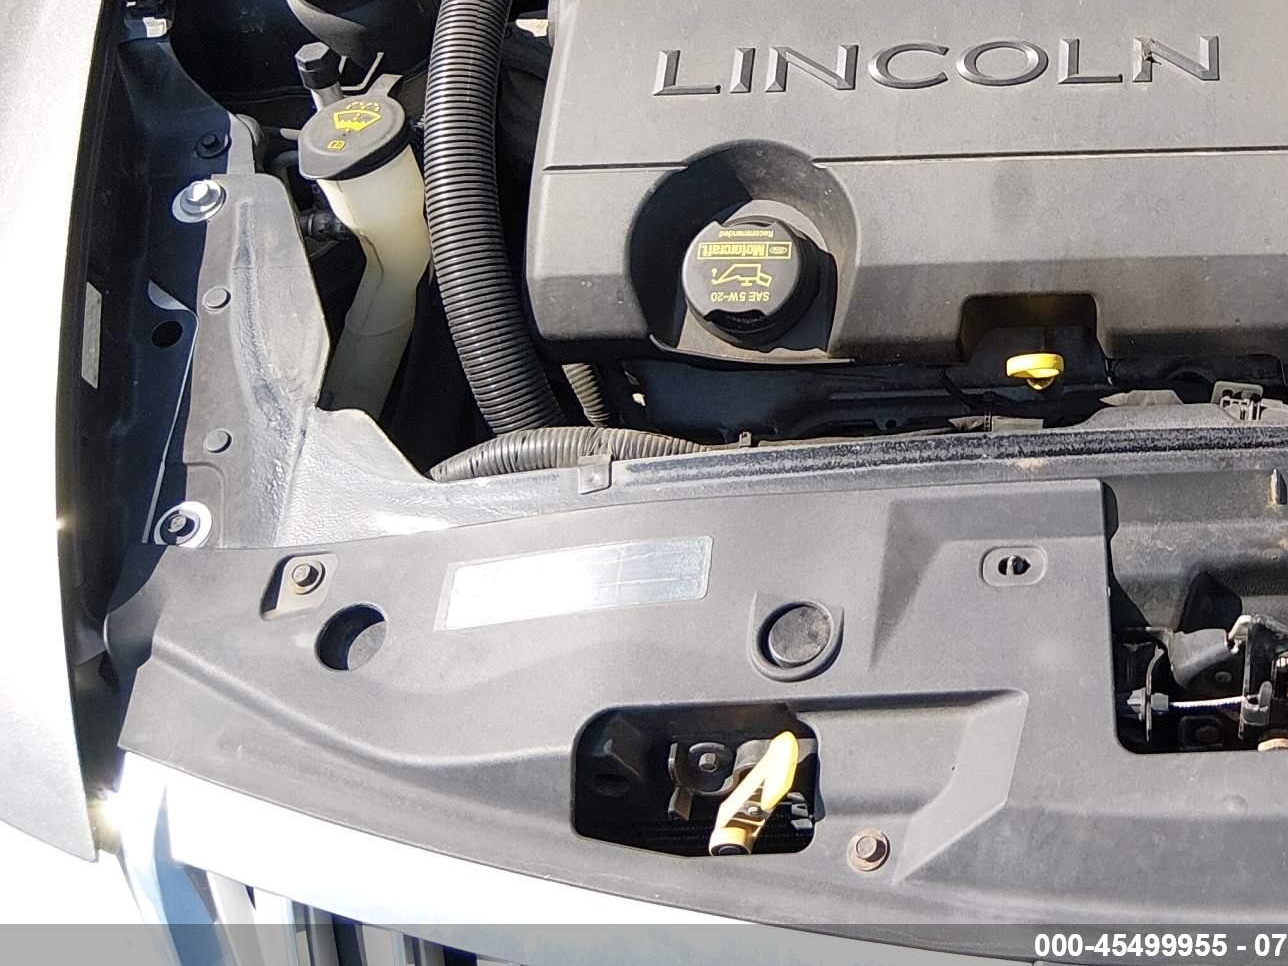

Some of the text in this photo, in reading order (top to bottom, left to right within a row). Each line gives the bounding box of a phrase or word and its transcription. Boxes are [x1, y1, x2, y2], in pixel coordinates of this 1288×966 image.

[652, 35, 1221, 96] LINCOLN
[719, 230, 774, 238] Recommended
[703, 244, 765, 257] Motorcraft
[711, 291, 770, 302] SAE 5W-20
